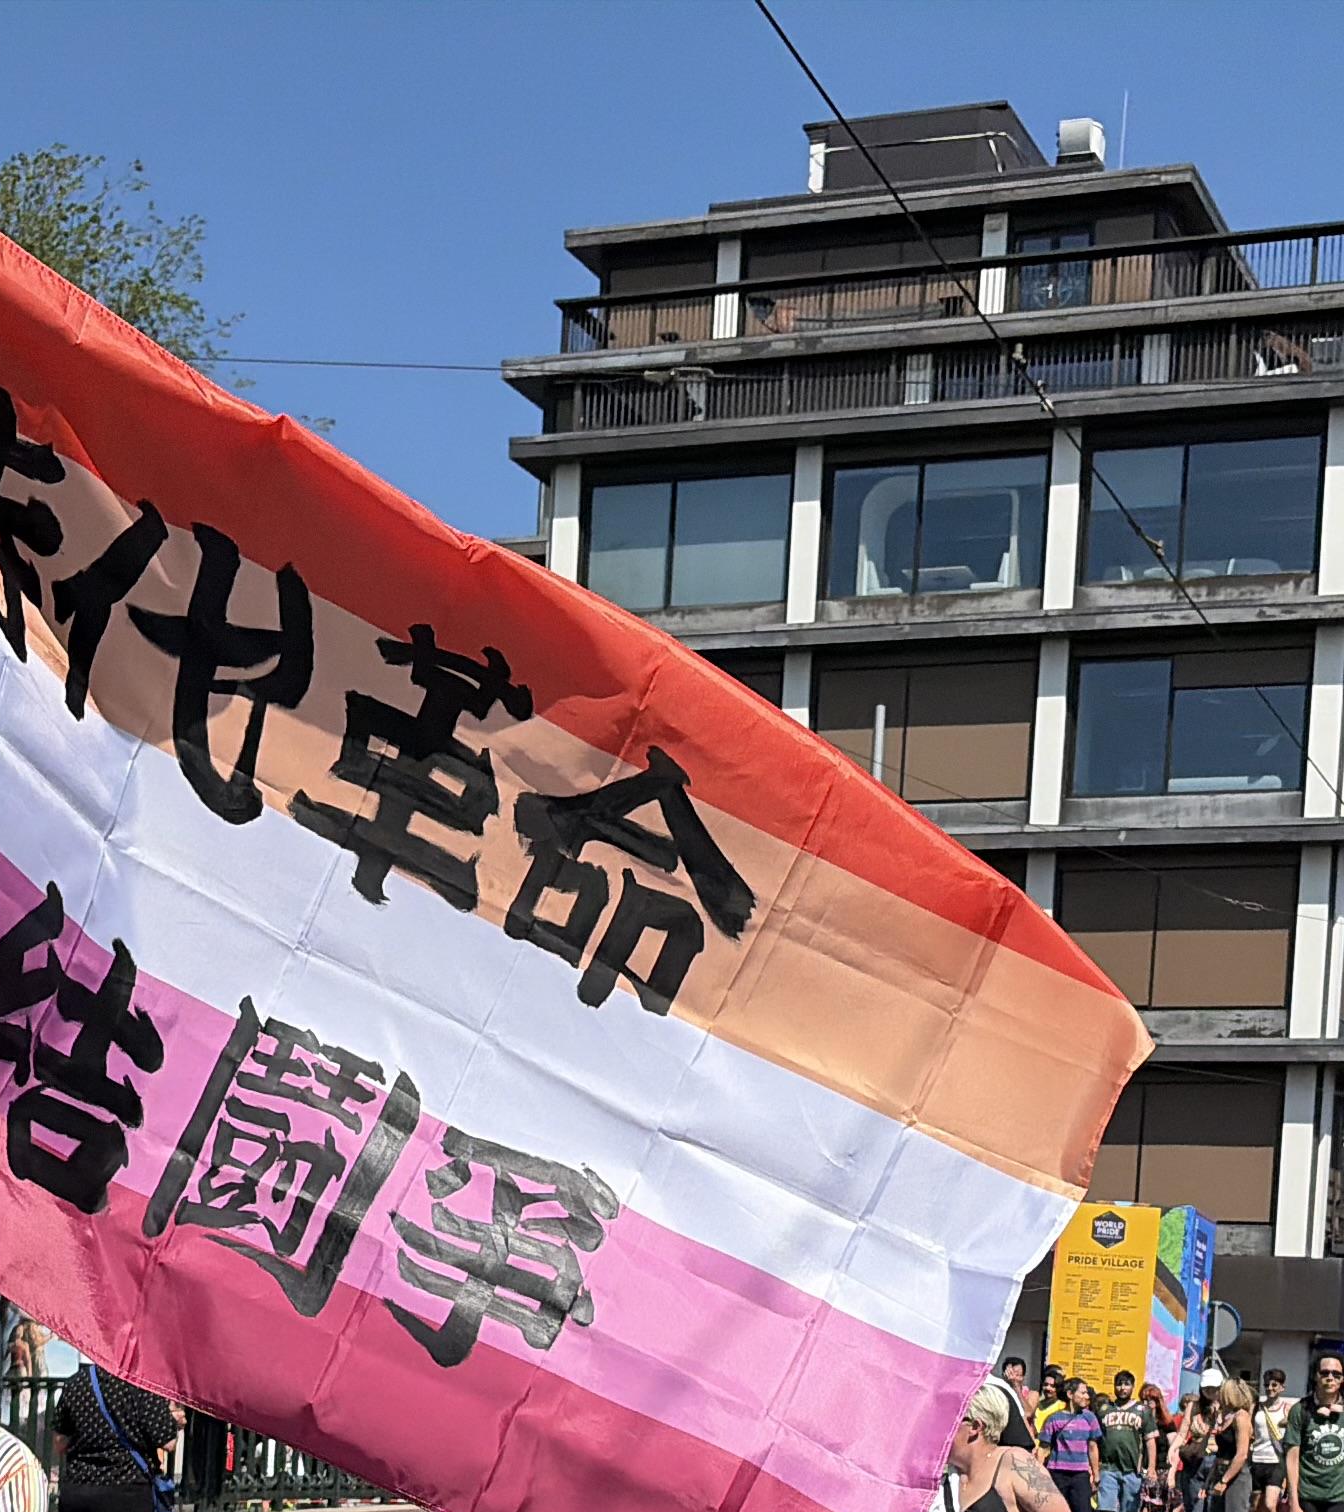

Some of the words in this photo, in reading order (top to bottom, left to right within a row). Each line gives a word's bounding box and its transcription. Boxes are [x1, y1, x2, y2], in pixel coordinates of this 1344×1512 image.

[1094, 1219, 1125, 1229] WORLD
[1067, 1255, 1098, 1265] PRIDE
[1101, 1257, 1144, 1268] VILLAGE
